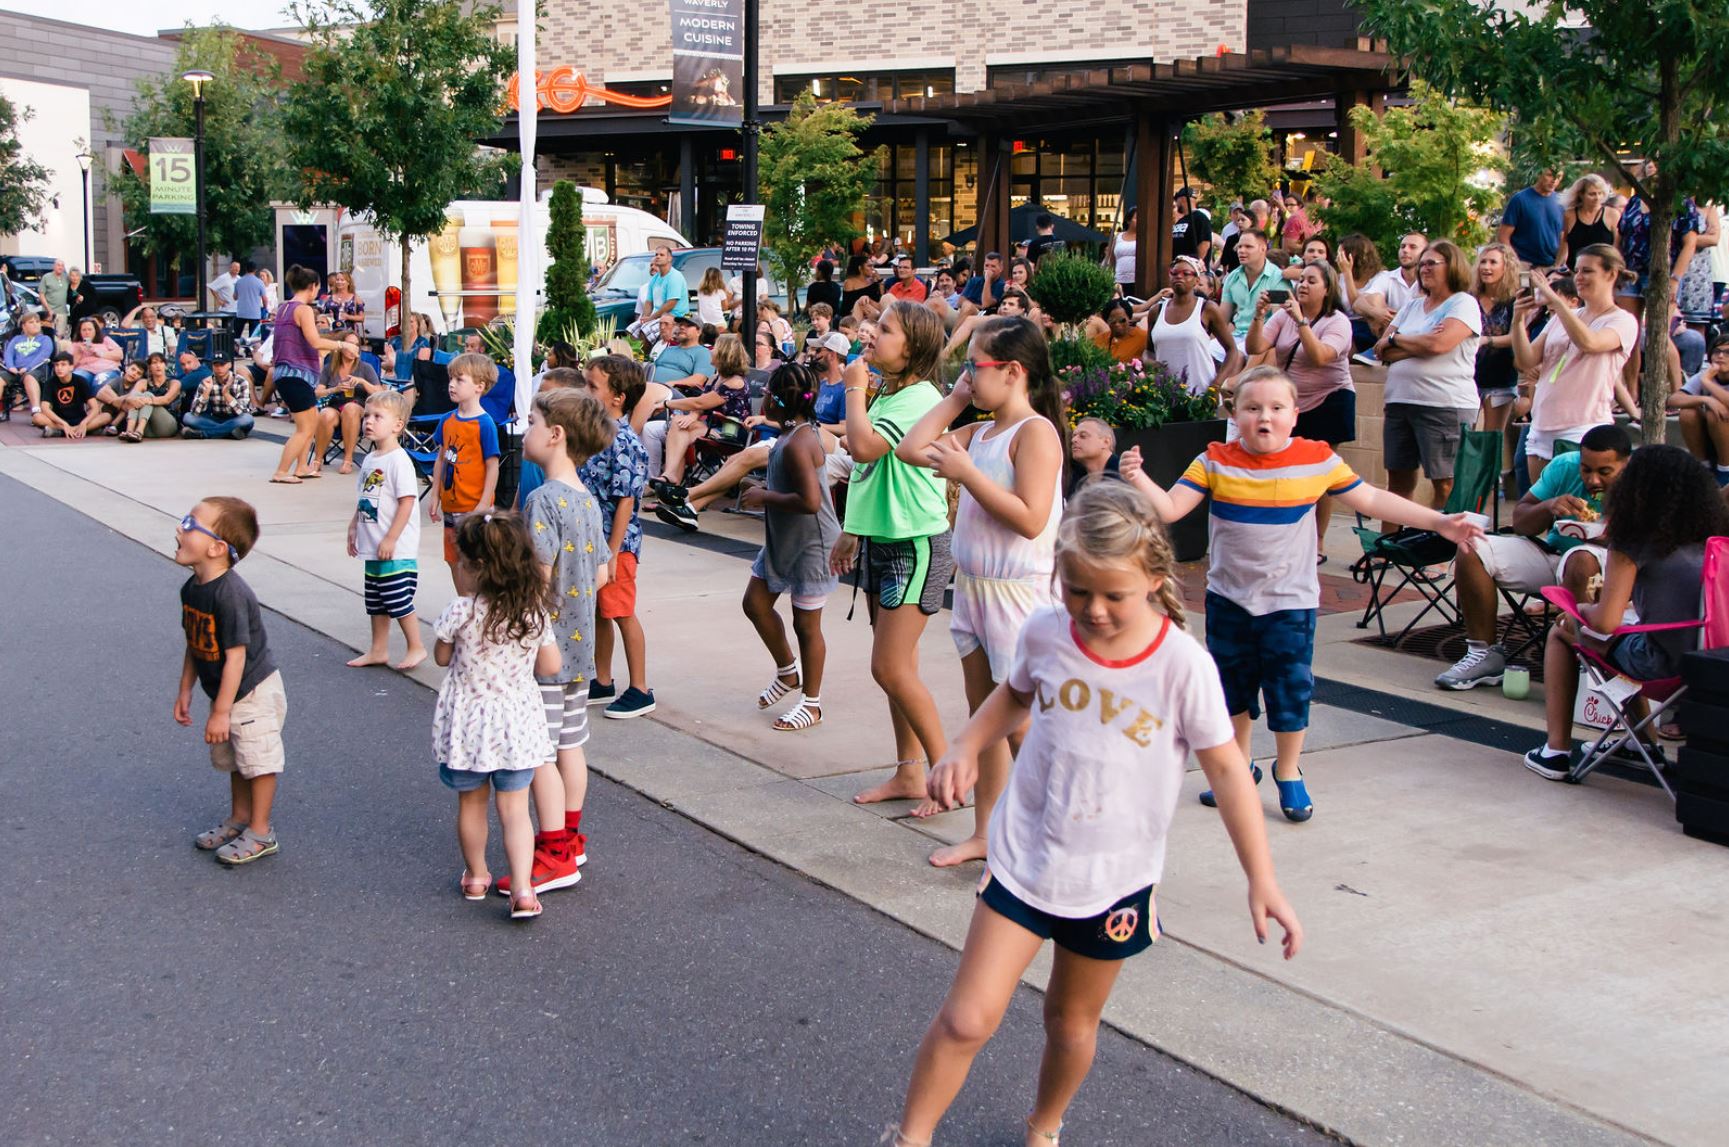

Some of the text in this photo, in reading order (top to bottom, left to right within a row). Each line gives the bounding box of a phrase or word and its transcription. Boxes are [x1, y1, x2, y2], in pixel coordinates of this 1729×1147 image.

[680, 17, 735, 31] MODERN
[683, 32, 733, 46] CUISINE
[155, 157, 191, 183] 15
[152, 193, 195, 201] PARKING
[357, 240, 383, 256] BORN
[1035, 678, 1163, 748] LOVE
